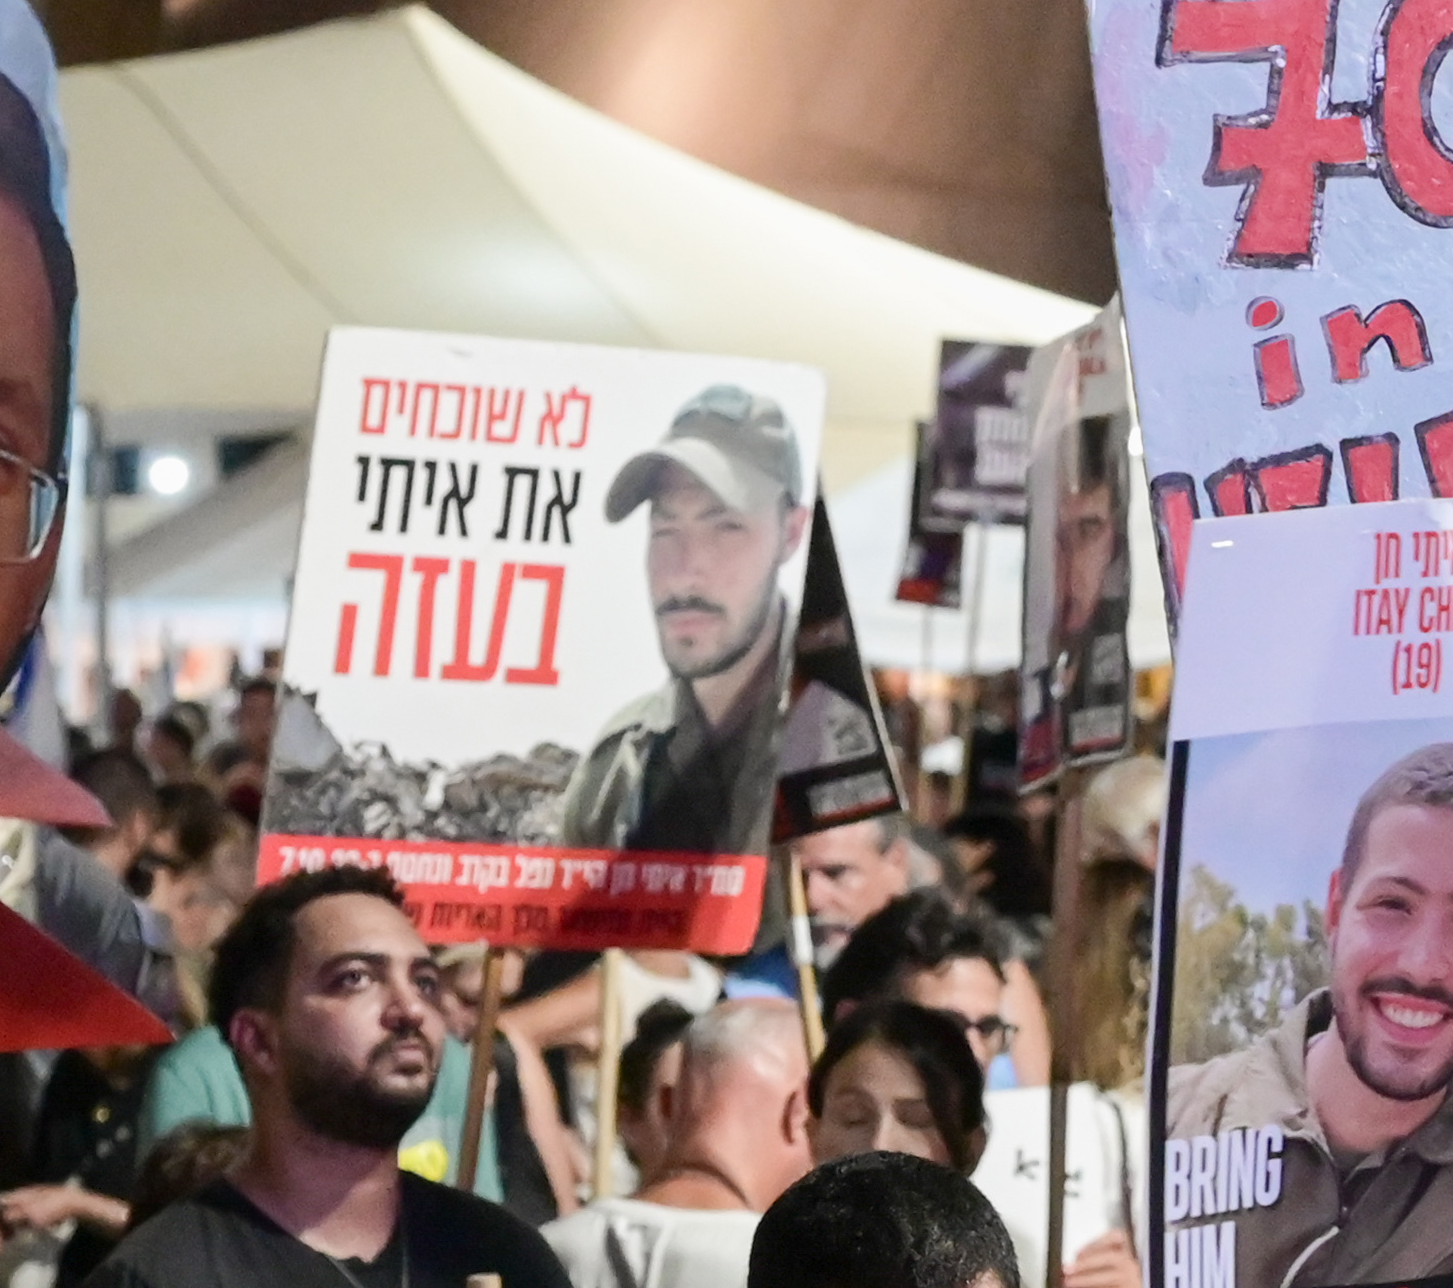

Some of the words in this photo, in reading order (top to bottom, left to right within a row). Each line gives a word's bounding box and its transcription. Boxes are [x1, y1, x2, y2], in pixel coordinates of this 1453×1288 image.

[1244, 295, 1433, 409] in
[359, 377, 526, 444] שוכחים
[536, 384, 593, 448] לא
[354, 455, 479, 538] איתי
[495, 462, 581, 545] את
[1374, 532, 1402, 585] חן
[333, 553, 566, 687] בעזה
[1353, 587, 1411, 636] ITAY
[1392, 639, 1442, 695] (19)
[1165, 1123, 1284, 1222] BRING
